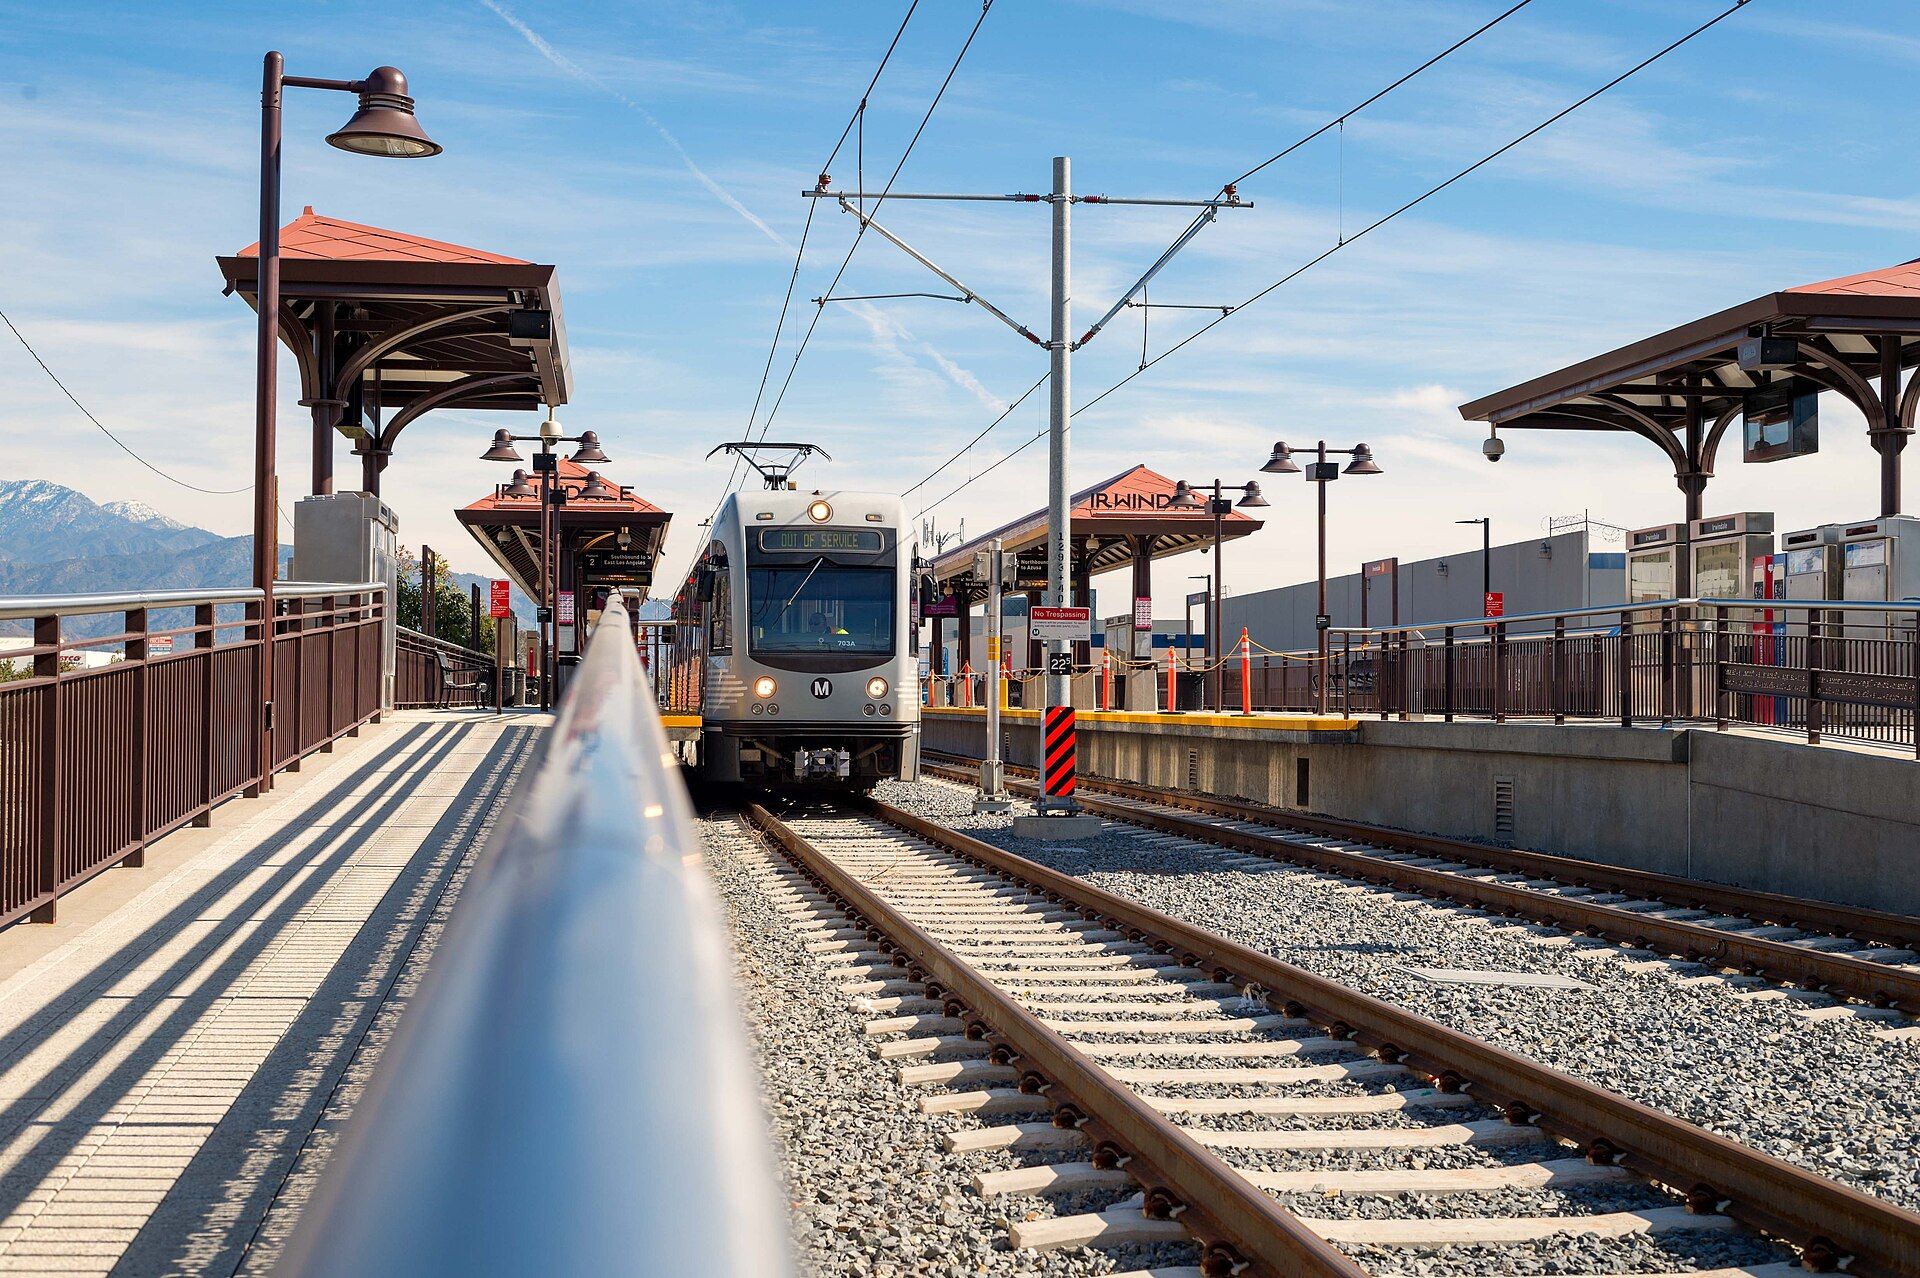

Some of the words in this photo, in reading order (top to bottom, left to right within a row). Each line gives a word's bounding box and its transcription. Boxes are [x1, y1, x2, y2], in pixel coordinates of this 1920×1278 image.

[1090, 492, 1222, 509] IRWIND
[781, 533, 798, 548] OUT
[803, 533, 815, 548] OF
[821, 533, 859, 548] SERVICE
[589, 558, 595, 566] 2
[1034, 610, 1045, 618] No
[1045, 610, 1086, 620] Trespassing
[813, 680, 830, 697] M
